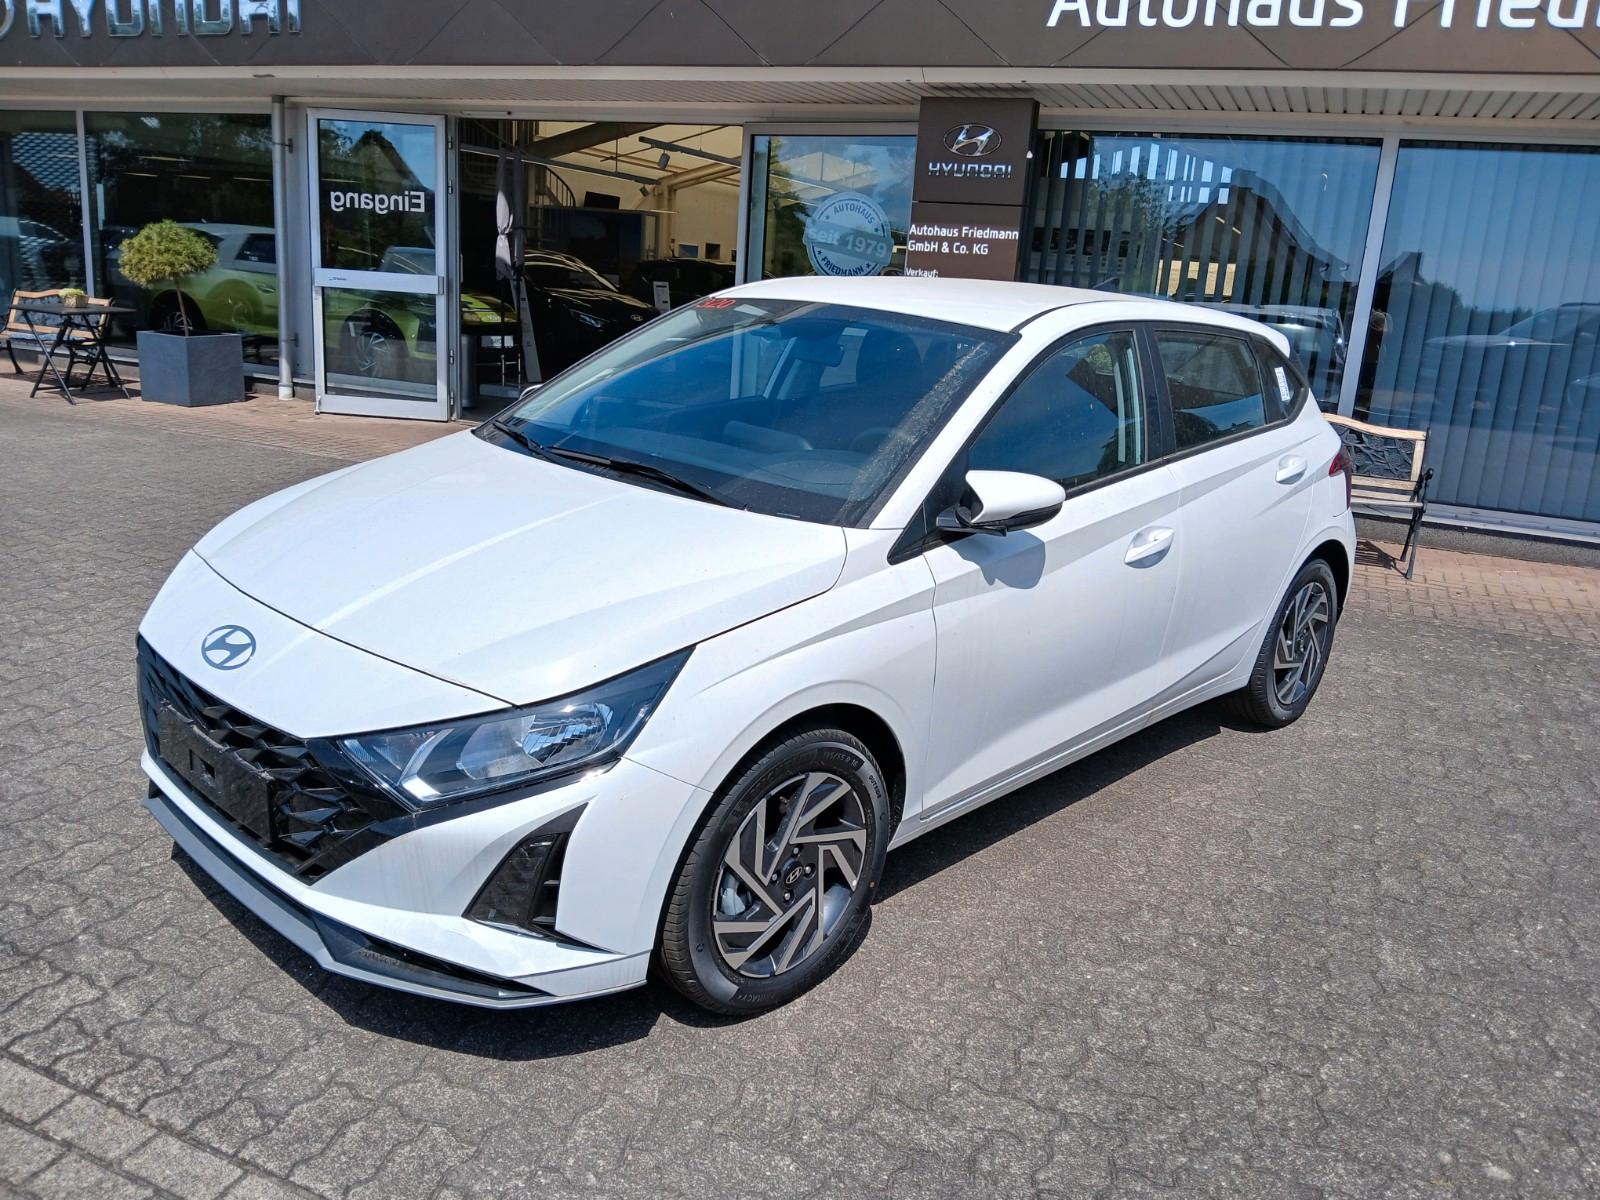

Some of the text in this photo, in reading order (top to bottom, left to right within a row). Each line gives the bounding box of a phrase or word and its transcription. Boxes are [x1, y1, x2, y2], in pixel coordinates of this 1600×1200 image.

[928, 162, 1012, 178] HYUNDAI
[833, 203, 876, 224] AUTOHAUS
[909, 224, 1019, 240] Autohaus Friedmann
[846, 234, 887, 258] 1979
[908, 240, 989, 255] GmbH & Co. KG
[821, 256, 865, 276] FRIEDMANN
